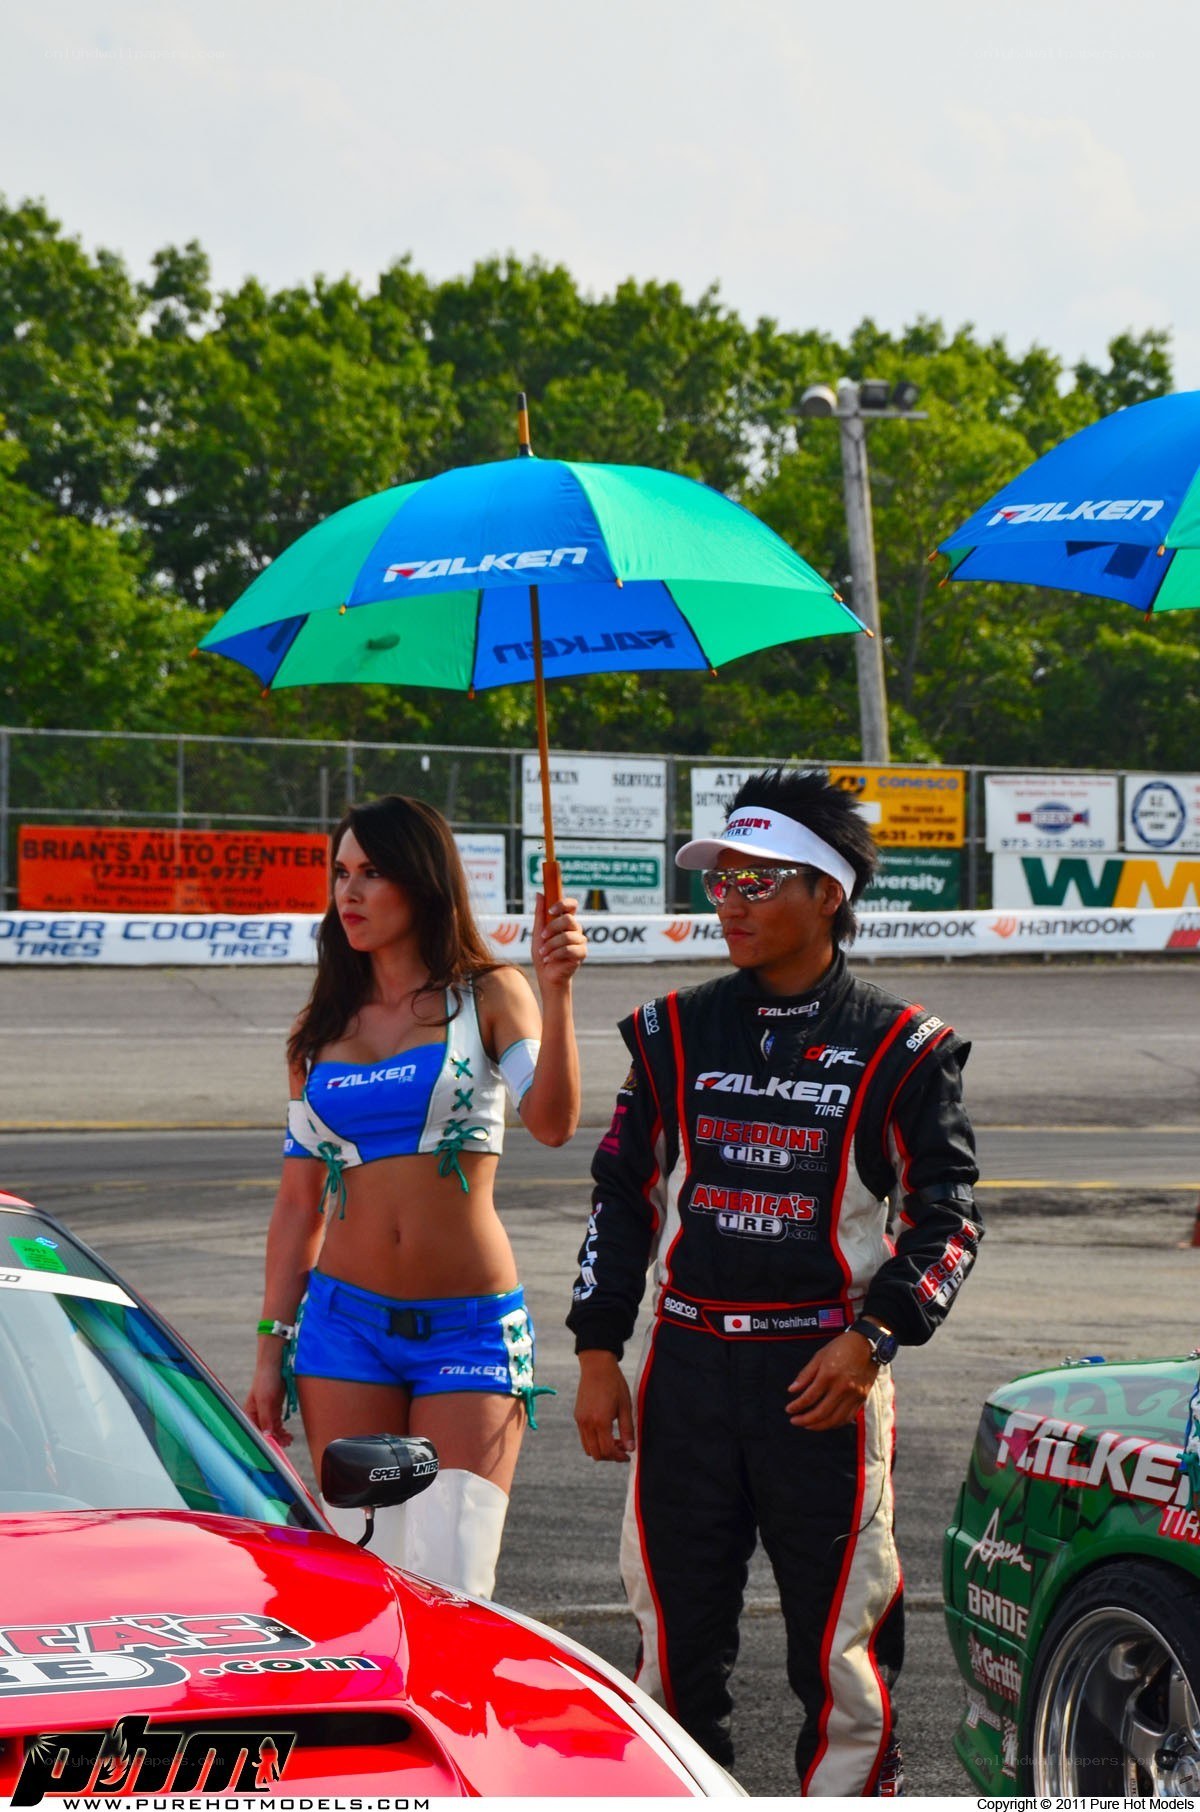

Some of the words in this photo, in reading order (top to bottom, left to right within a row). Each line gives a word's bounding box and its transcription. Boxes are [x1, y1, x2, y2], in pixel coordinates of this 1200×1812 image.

[986, 499, 1165, 527] FALKEN
[383, 547, 588, 583] FALKEN
[22, 839, 132, 862] BRIAN'S
[141, 844, 214, 864] AUTO
[224, 844, 323, 867] CENTER
[867, 873, 946, 895] iversity
[122, 921, 293, 941] COOPER
[15, 942, 103, 957] TIRES
[208, 943, 290, 958] TIRES
[757, 1001, 819, 1016] FALKEN
[905, 1016, 945, 1051] sparco
[327, 1064, 416, 1090] FALKEN
[694, 1071, 850, 1104] FALKEN
[814, 1104, 846, 1117] TIRE
[696, 1115, 826, 1155] DISCOUNT
[727, 1144, 783, 1166] TIRE
[690, 1183, 816, 1222] AMERICA'S
[720, 1214, 776, 1234] TIRE
[664, 1297, 698, 1320] sparco
[773, 1315, 818, 1329] Yoshihara
[439, 1366, 508, 1377] FALKEN
[1162, 1504, 1200, 1538] TIR
[968, 1583, 1029, 1639] BRIDE
[199, 1656, 382, 1676] .com
